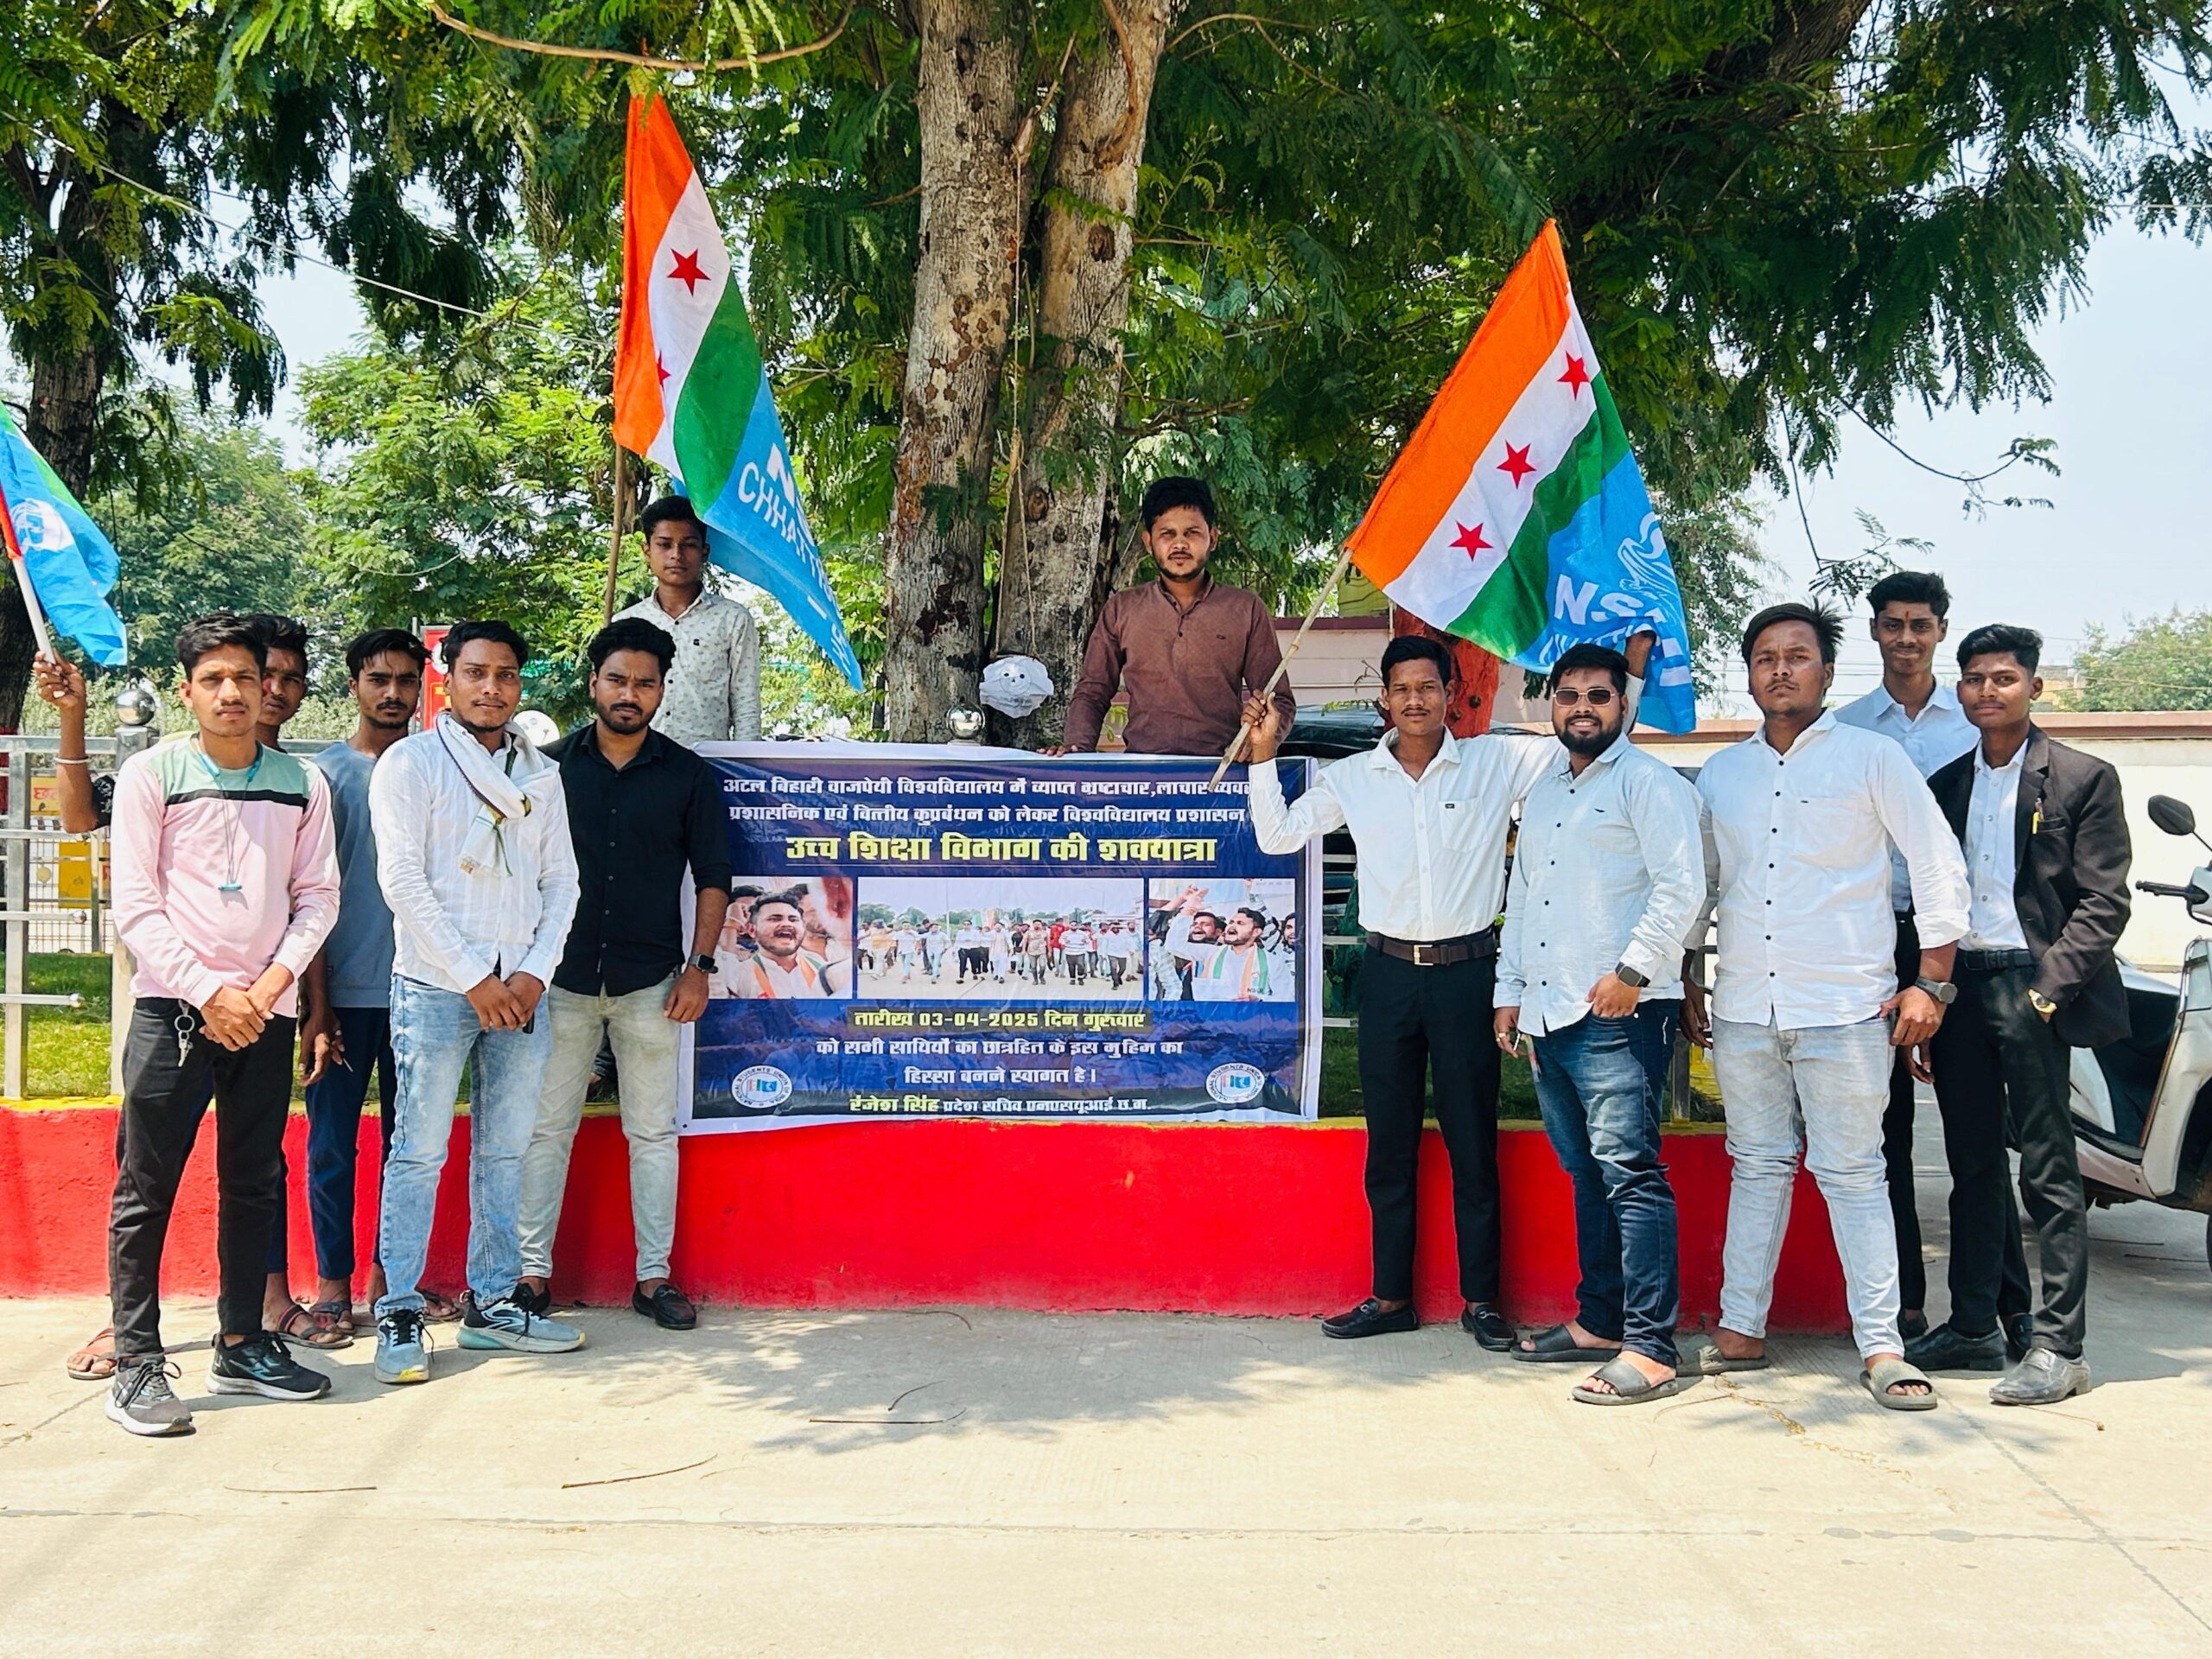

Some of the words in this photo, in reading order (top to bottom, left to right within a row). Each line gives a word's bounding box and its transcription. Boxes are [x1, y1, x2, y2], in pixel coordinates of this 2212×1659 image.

[724, 779, 766, 793] अटल
[772, 777, 823, 794] बिहारी
[828, 777, 892, 794] वाजपेयी
[898, 777, 1004, 794] विश्वविद्यालय
[1032, 781, 1076, 795] व्याप्त
[729, 804, 821, 821] प्रशासनिक
[824, 804, 848, 821] एवं
[853, 804, 909, 822] वित्तीय
[988, 804, 1011, 822] को
[1015, 804, 1059, 822] लेकर
[1063, 804, 1172, 823] विश्वविद्यालय
[1175, 808, 1246, 823] प्रशासन
[785, 836, 841, 860] उच्च
[848, 831, 931, 861] शिक्षा
[941, 831, 1042, 861] विभाग
[1050, 832, 1090, 861] की
[1097, 838, 1217, 861] शवयात्रा
[855, 1008, 914, 1027] तारीख
[919, 1012, 1038, 1027] 03-04-2025
[1044, 1009, 1079, 1027] दिन
[1083, 1013, 1146, 1032] गुरुवार
[817, 1037, 840, 1055] को
[844, 1037, 885, 1055] सभी
[889, 1037, 950, 1055] साथियों
[954, 1040, 978, 1055] का
[982, 1038, 1045, 1054] छात्रहित
[1048, 1038, 1067, 1054] के
[1069, 1041, 1098, 1055] इस
[1160, 1041, 1184, 1054] का
[904, 1065, 956, 1084] हिस्सा
[1010, 1069, 1069, 1083] स्वागत
[903, 1094, 940, 1112] सिंह
[943, 1097, 979, 1112] प्रदेश
[982, 1097, 1022, 1112] सचिव
[1027, 1096, 1114, 1114] एनएसयूआई
